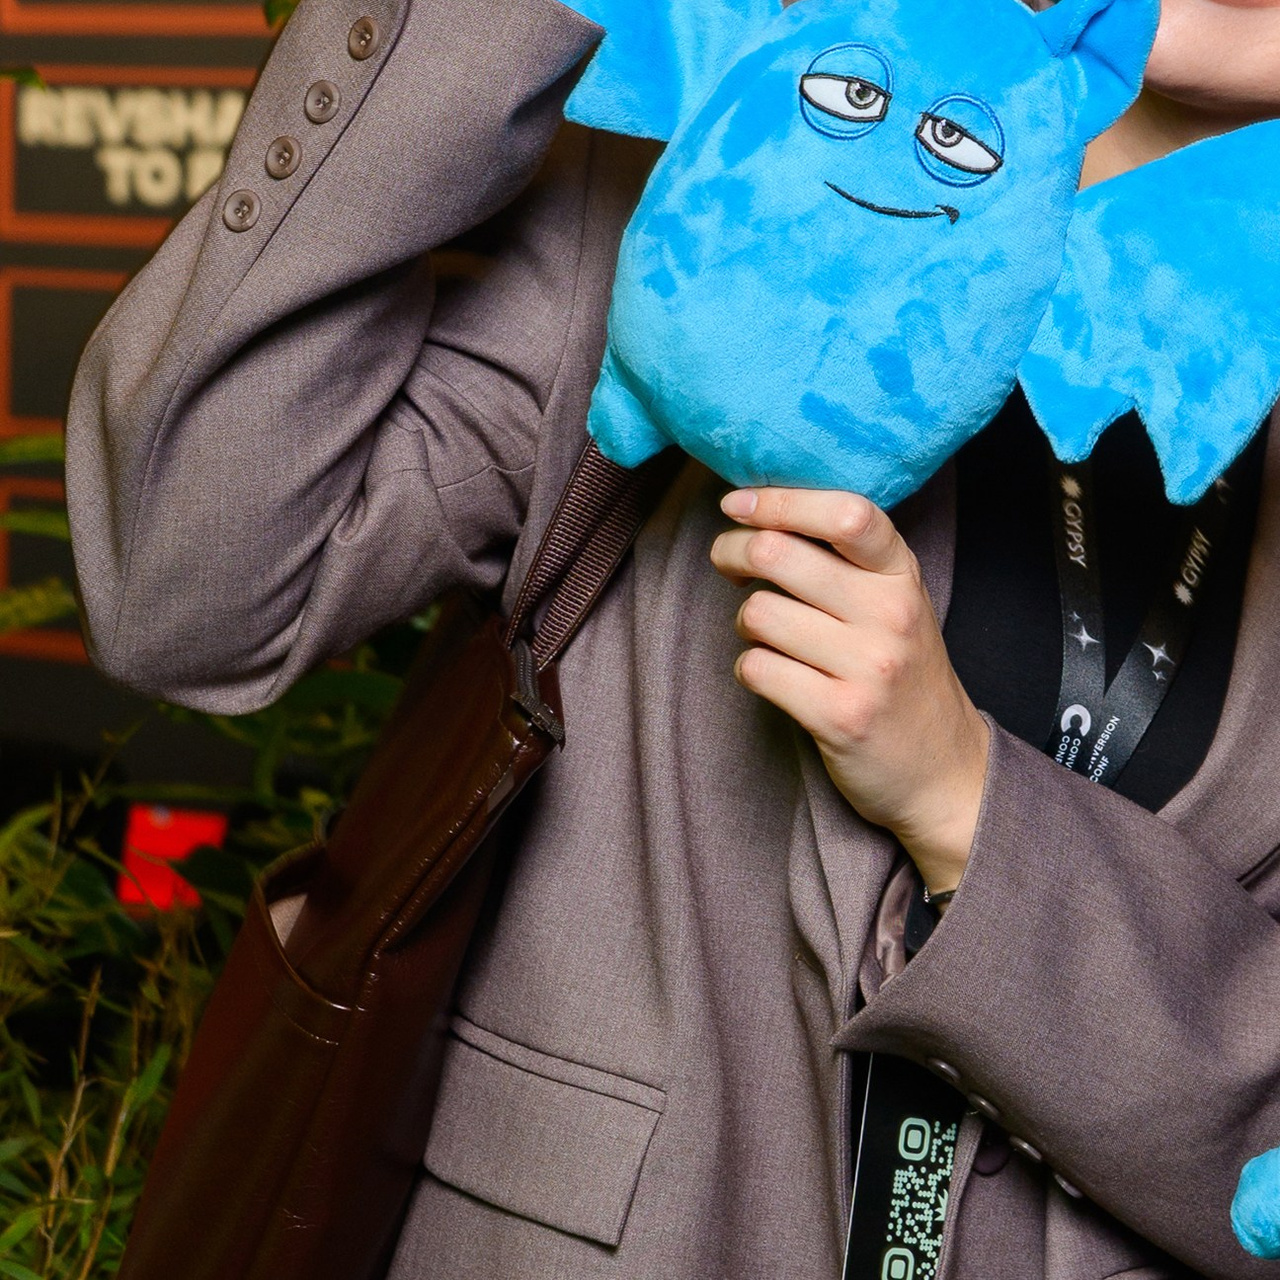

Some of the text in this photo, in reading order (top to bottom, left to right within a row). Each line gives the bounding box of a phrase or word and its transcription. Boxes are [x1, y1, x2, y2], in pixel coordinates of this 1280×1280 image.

[1064, 502, 1088, 569] GYPSY
[1181, 526, 1212, 587] GYPSY
[1090, 756, 1110, 783] CONF
